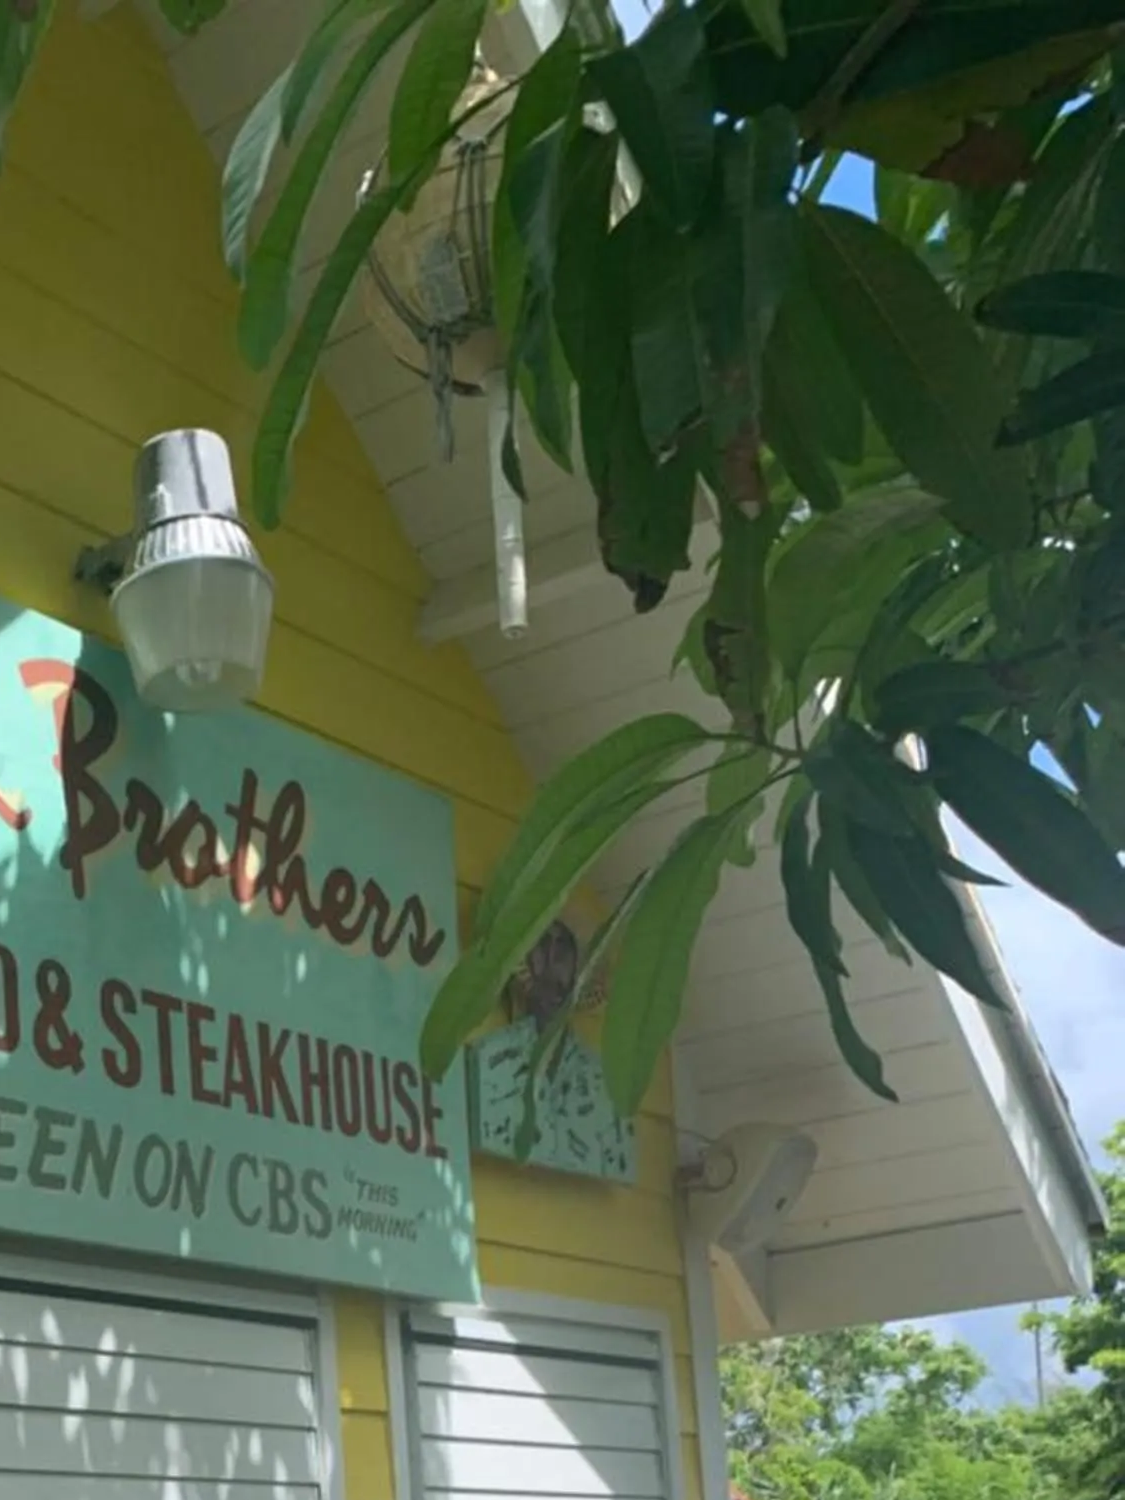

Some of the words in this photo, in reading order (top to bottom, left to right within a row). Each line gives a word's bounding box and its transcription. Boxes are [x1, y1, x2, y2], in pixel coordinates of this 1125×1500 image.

[18, 658, 447, 967] Brothers
[33, 958, 85, 1074] &
[101, 978, 448, 1162] STEAKHOUSE
[133, 1133, 215, 1231] ON
[227, 1150, 334, 1241] CBS
